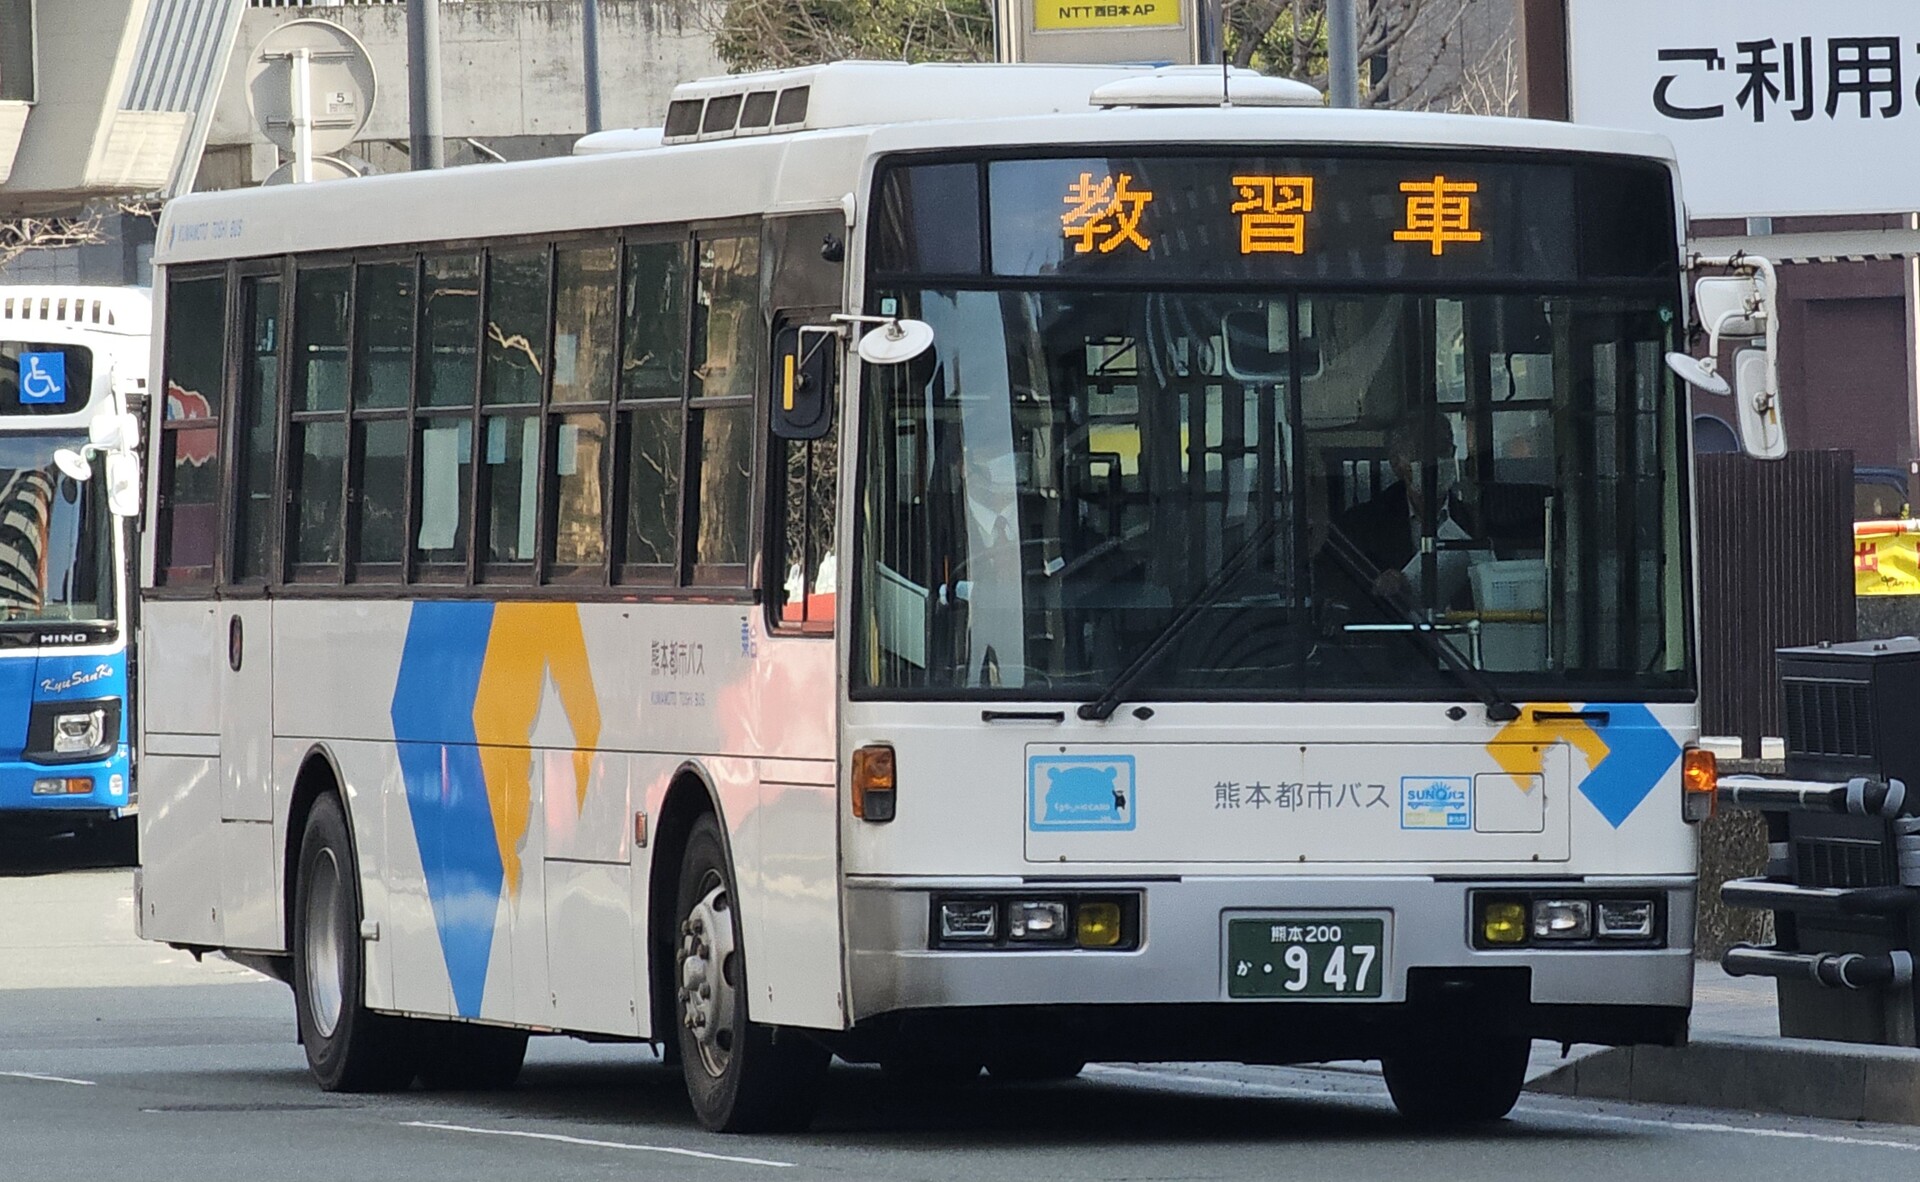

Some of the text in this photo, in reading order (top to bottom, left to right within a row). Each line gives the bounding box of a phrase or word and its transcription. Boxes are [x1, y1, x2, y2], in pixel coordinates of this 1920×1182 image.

[1652, 36, 1920, 122] ご利用
[336, 92, 345, 103] 5
[1060, 173, 1482, 256] 教習車
[40, 633, 88, 643] HINO
[650, 640, 706, 680] 熊本都市バス
[40, 663, 114, 693] KyuSanKo
[1213, 781, 1390, 812] 熊本都市バス
